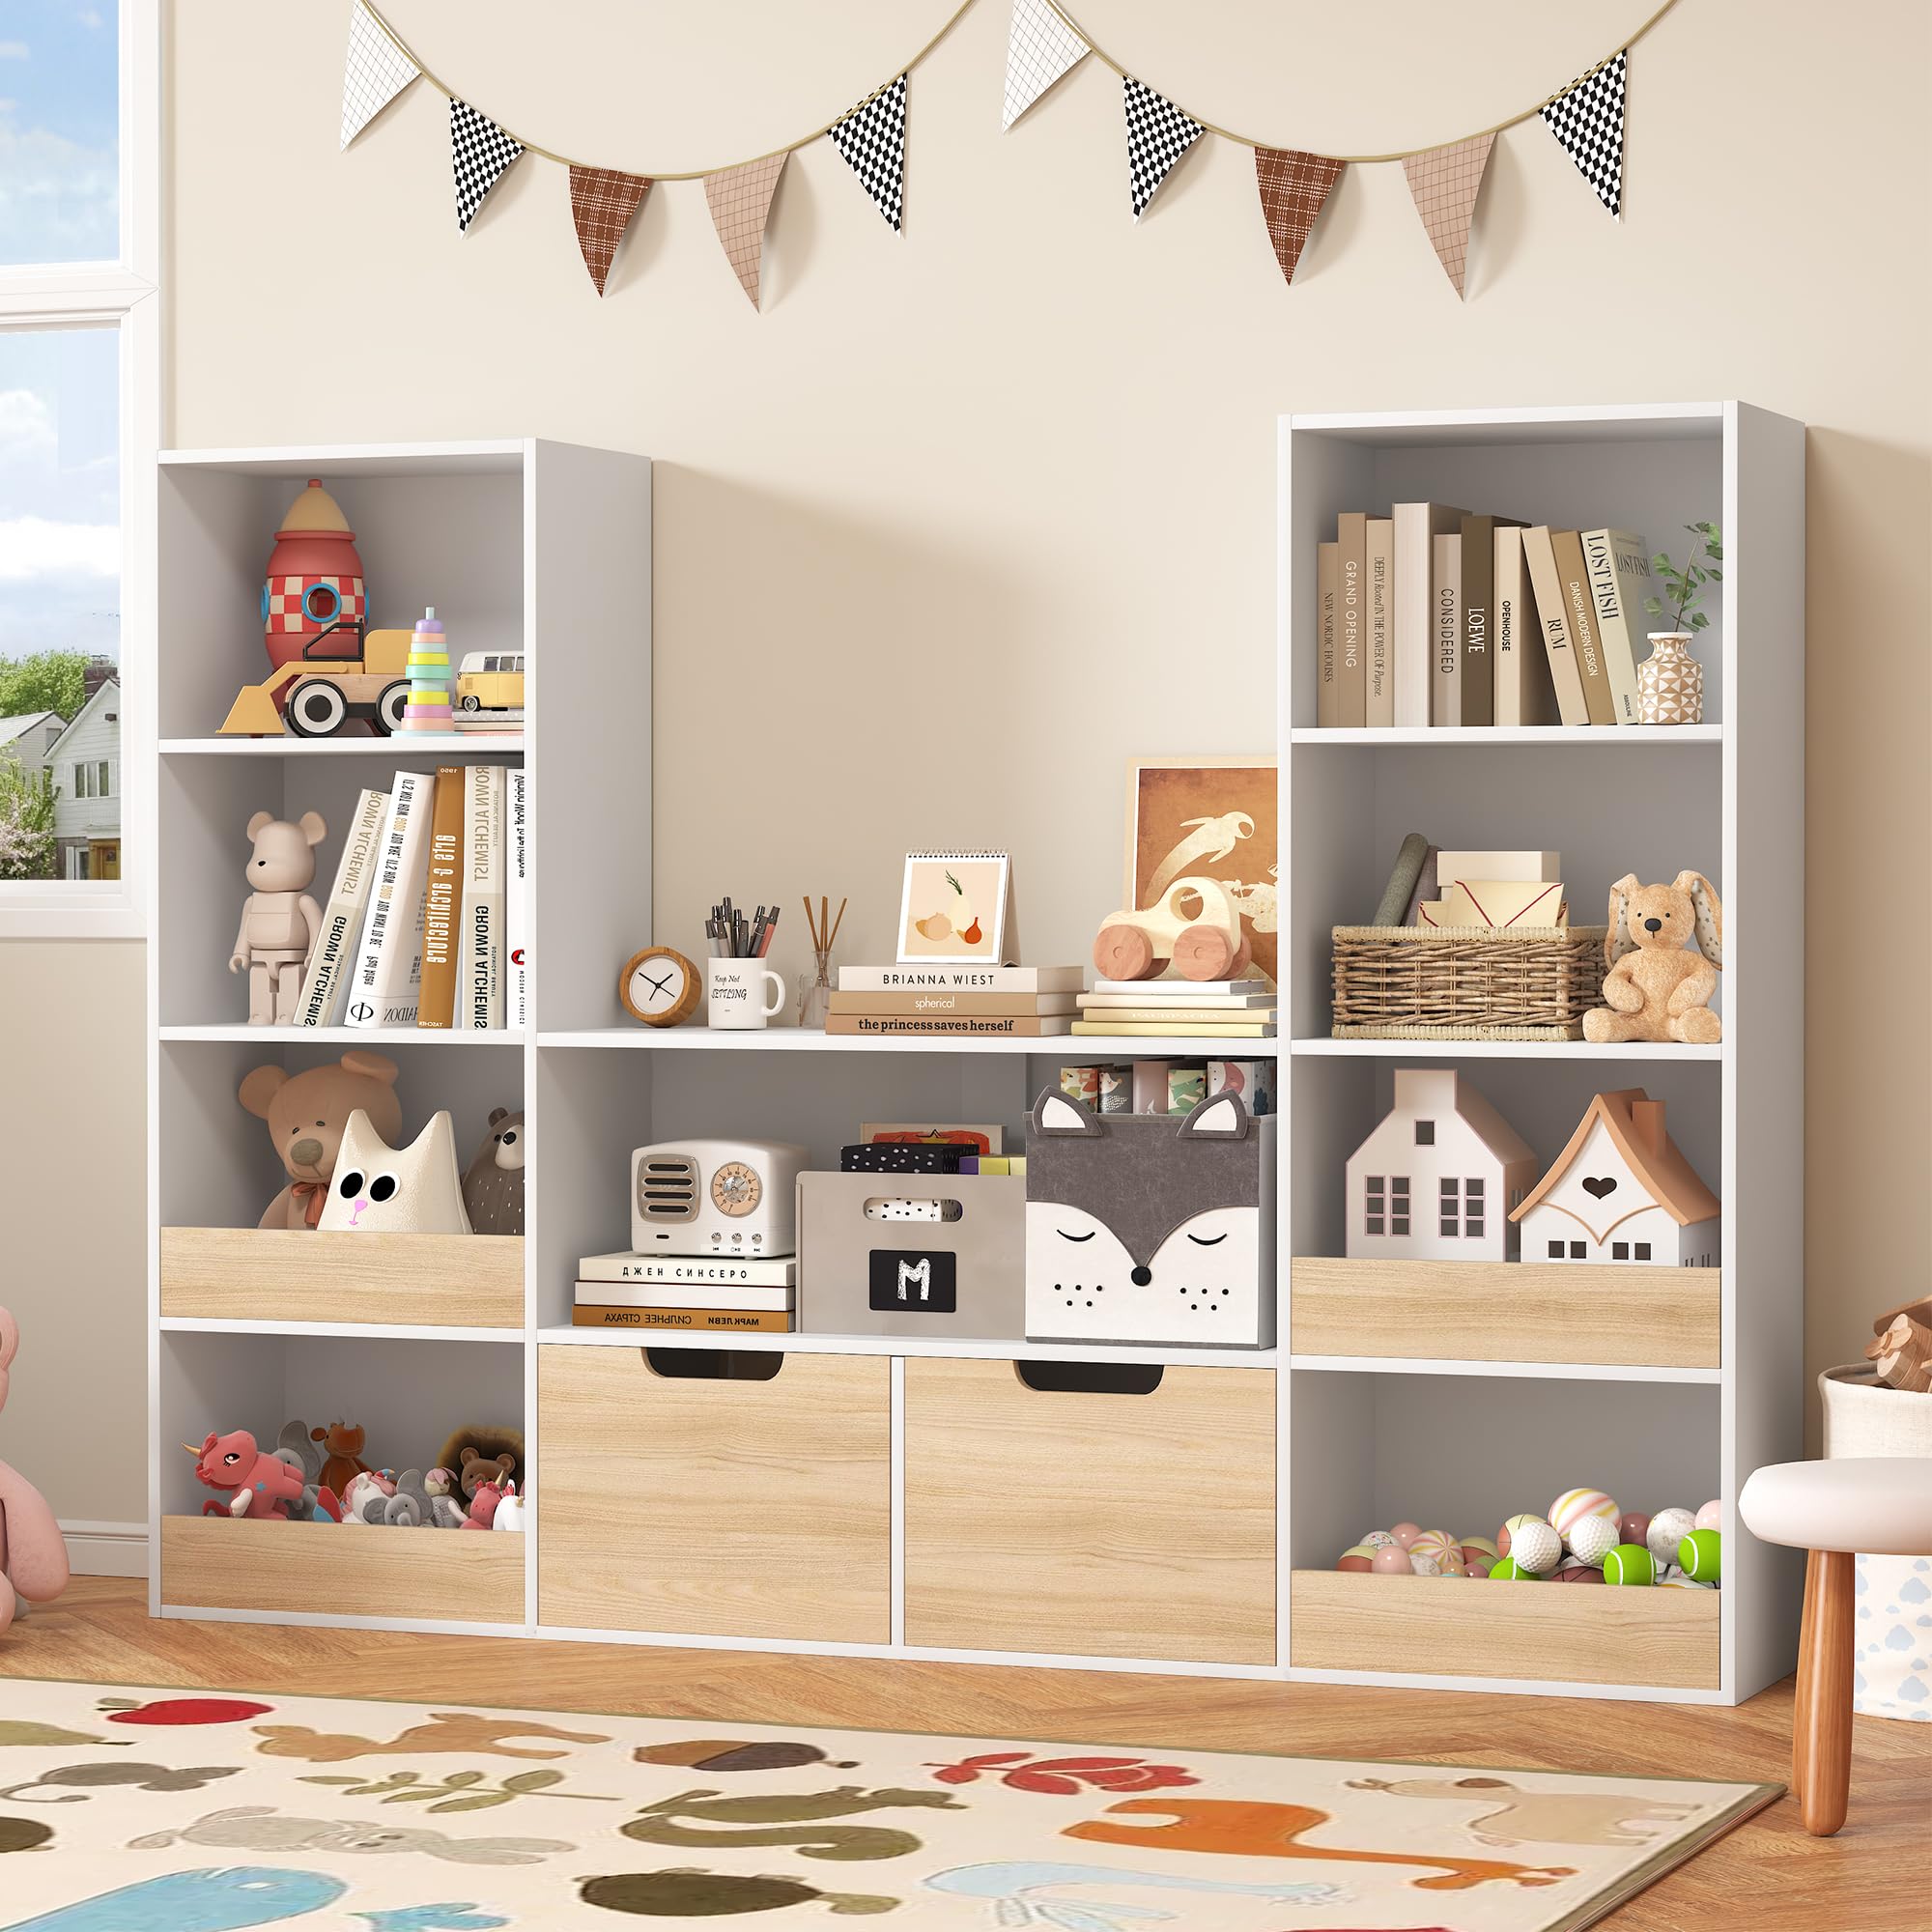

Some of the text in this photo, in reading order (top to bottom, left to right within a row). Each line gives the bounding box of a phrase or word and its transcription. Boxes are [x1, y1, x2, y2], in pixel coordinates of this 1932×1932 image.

[1374, 556, 1385, 582] DEEPLY
[1587, 535, 1619, 619] LOST FISH
[1374, 583, 1384, 606] Rooted
[1346, 560, 1357, 668] GRAND OPENING
[1375, 607, 1384, 615] IN
[1375, 616, 1384, 631] THE
[1324, 592, 1334, 683] NEW NORDIC HOUSES
[1440, 588, 1454, 674] CONSIDERED
[1468, 608, 1485, 653] LOEWE
[1501, 600, 1511, 652] OPENHOUSE
[1547, 618, 1567, 650] RUM
[1569, 582, 1599, 676] DANISH MODERN DESIGN
[1375, 632, 1384, 658] POWER
[1375, 659, 1384, 669] OF
[714, 975, 727, 985] Keep
[883, 974, 995, 985] BRIANNA WIEST
[711, 988, 747, 1001] SETTLING
[915, 996, 955, 1010] spherical
[859, 1018, 1014, 1033] the princess saves herself
[622, 1266, 748, 1279] ДЖЕН СИНСЕРО
[896, 1257, 931, 1301] M
